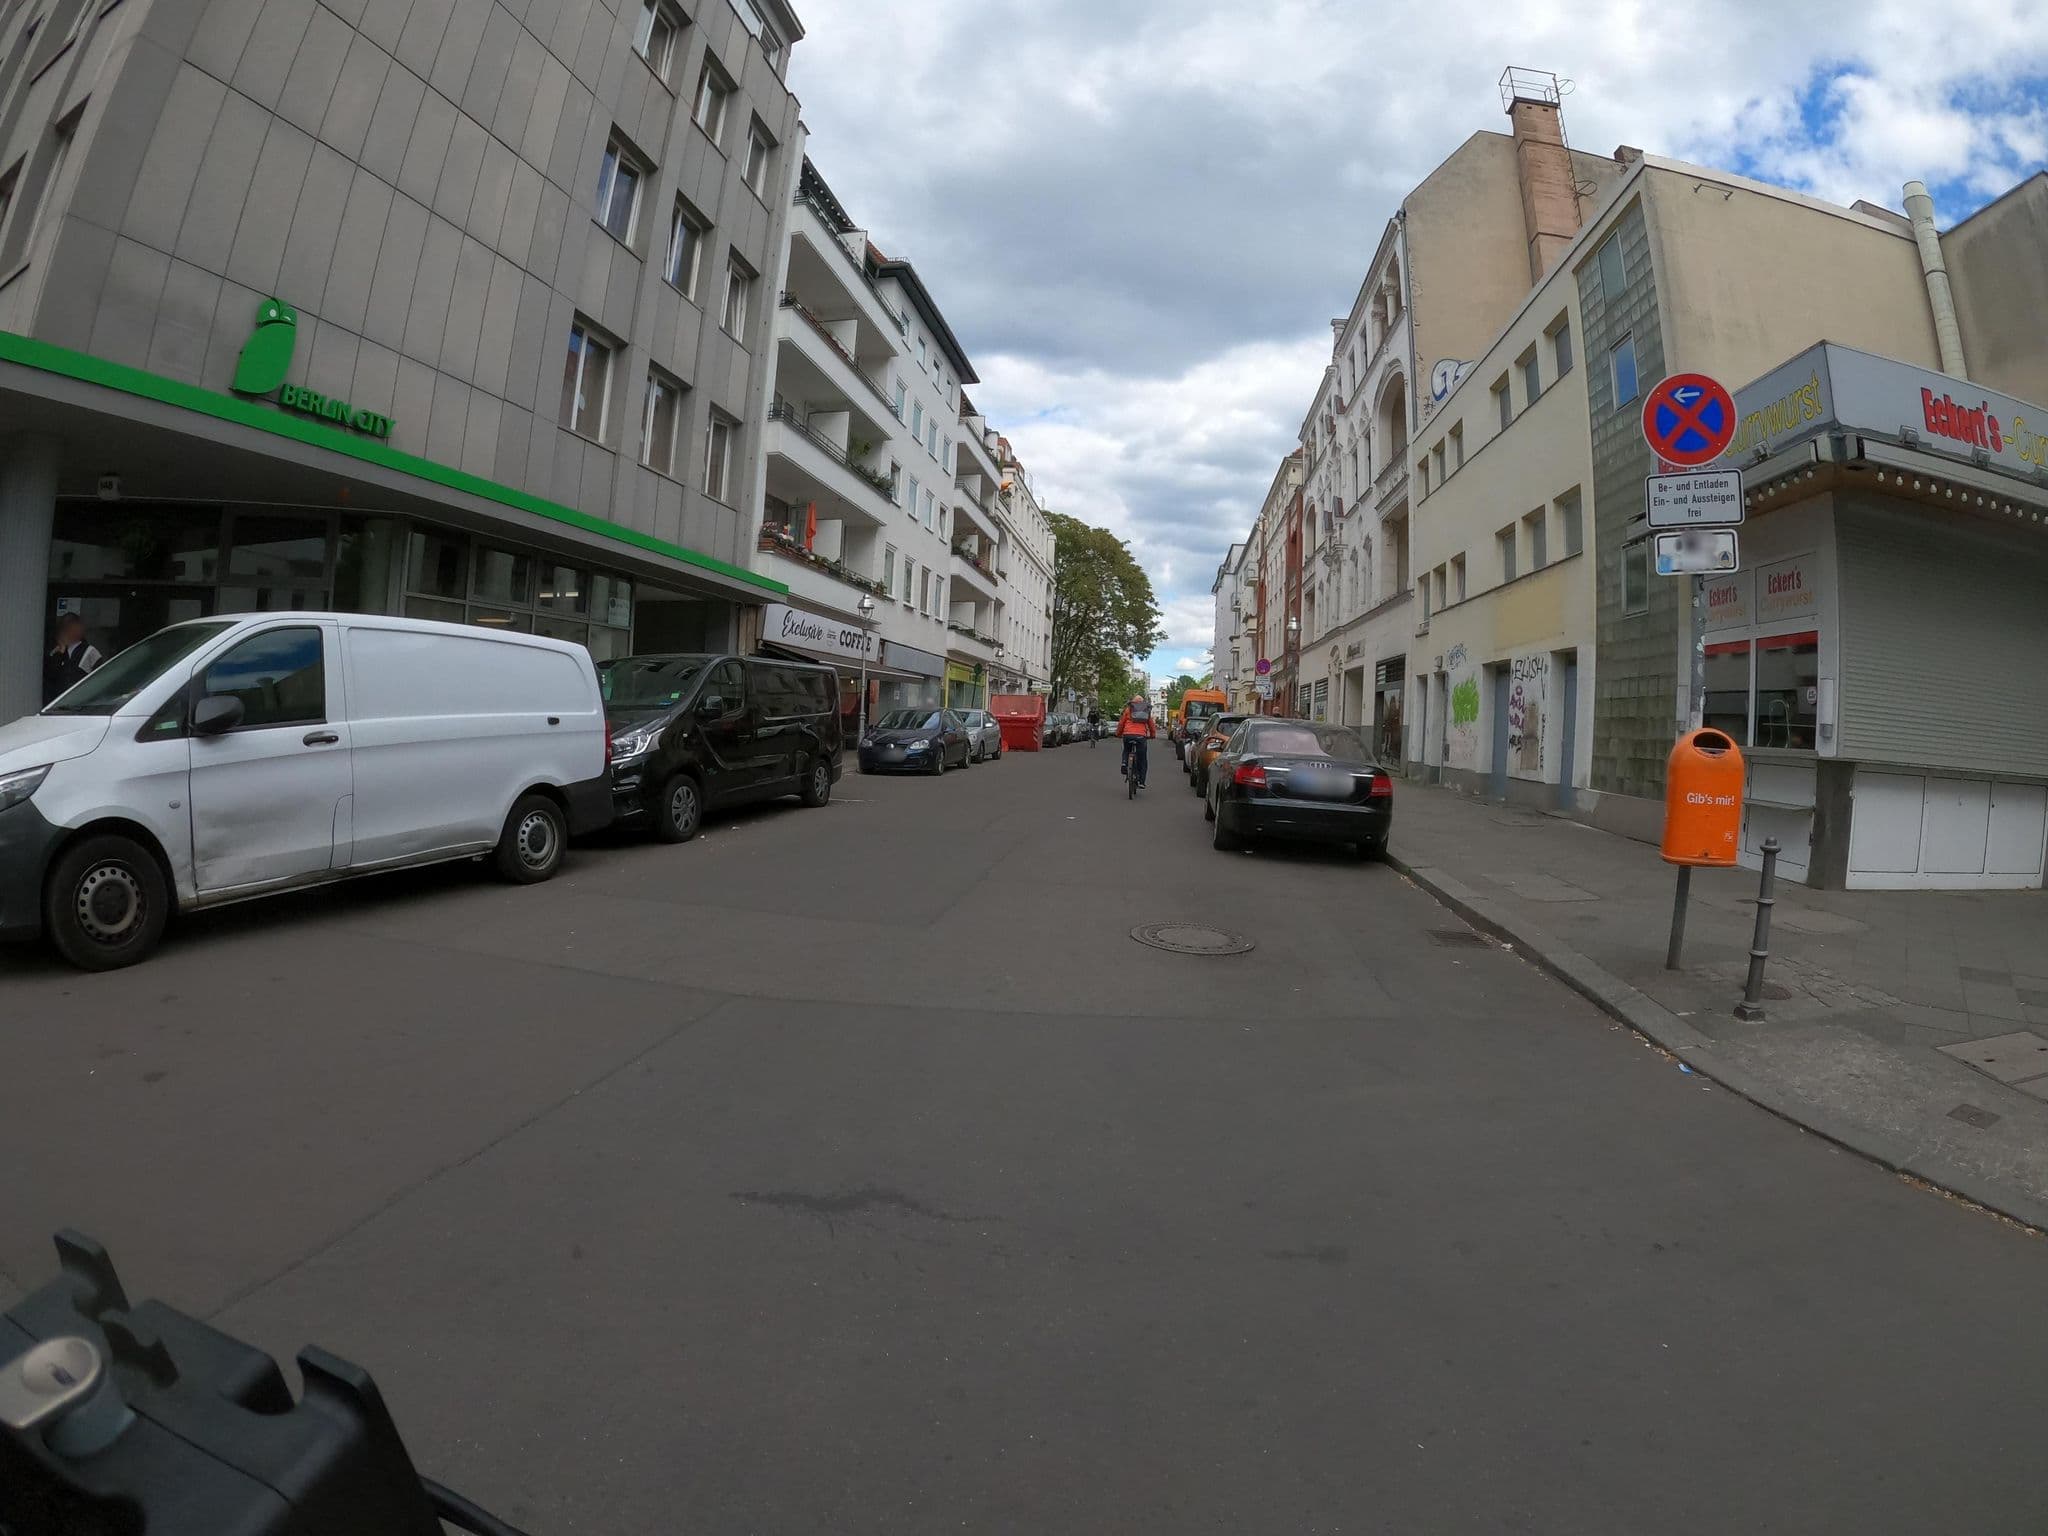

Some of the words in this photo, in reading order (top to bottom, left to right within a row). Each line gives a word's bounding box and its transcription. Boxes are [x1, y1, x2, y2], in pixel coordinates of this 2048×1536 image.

[280, 383, 352, 425] BERLIN
[355, 409, 398, 438] CITY
[1658, 483, 1673, 493] Be-
[1676, 480, 1691, 491] und
[1693, 479, 1729, 490] Entladen
[1653, 496, 1671, 507] Ein-
[1673, 494, 1688, 505] und
[1691, 492, 1736, 505] Aussteigen
[1687, 507, 1702, 518] frei
[1767, 566, 1802, 595] Eckert's
[1709, 583, 1738, 608] Eckert's
[781, 609, 824, 642] Exclusive
[1686, 792, 1713, 806] Gib's
[1715, 794, 1735, 806] mir!
